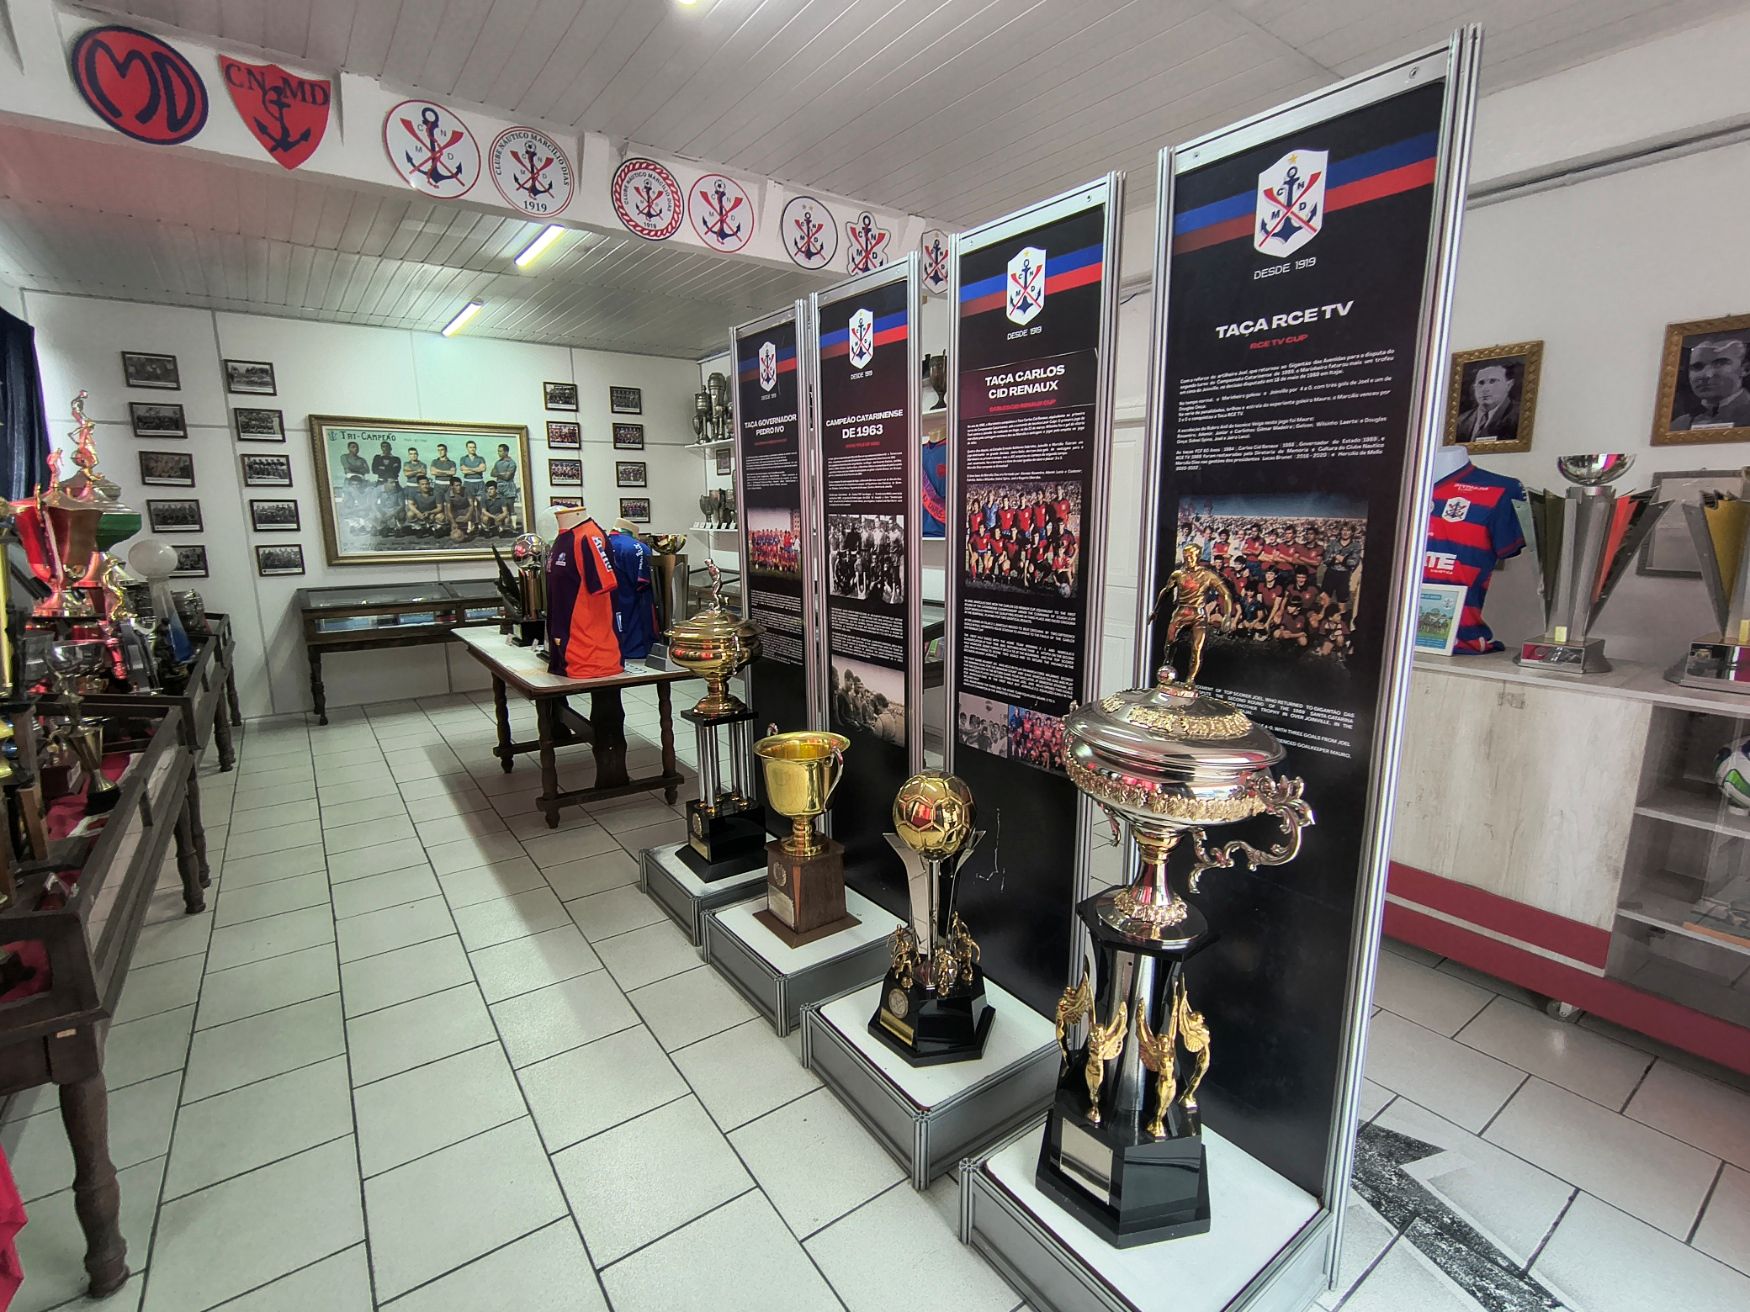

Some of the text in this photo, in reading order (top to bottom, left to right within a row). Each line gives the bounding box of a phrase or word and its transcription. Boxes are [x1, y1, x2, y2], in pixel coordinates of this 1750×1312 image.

[225, 64, 329, 105] CN MD
[417, 124, 447, 137] C N
[415, 145, 454, 161] M D
[494, 149, 502, 176] CLUBE
[498, 132, 529, 150] NÁUTICO
[561, 166, 570, 186] DIAS
[1276, 181, 1304, 196] C N
[523, 200, 547, 212] 1919
[1271, 202, 1306, 219] M D
[1254, 257, 1317, 280] DESDE 1919
[1215, 300, 1354, 338] TAÇA RCE TV
[1007, 329, 1028, 341] DESDE
[1285, 333, 1309, 343] CUP
[985, 364, 1065, 386] TAÇA CARLOS
[988, 380, 1059, 399] CID RENAUX
[758, 413, 797, 427] GOVERNADOR
[826, 409, 904, 427] CAMPEÃO CATARINENSE
[756, 427, 774, 436] PEDRO
[842, 424, 884, 439] DE 1963
